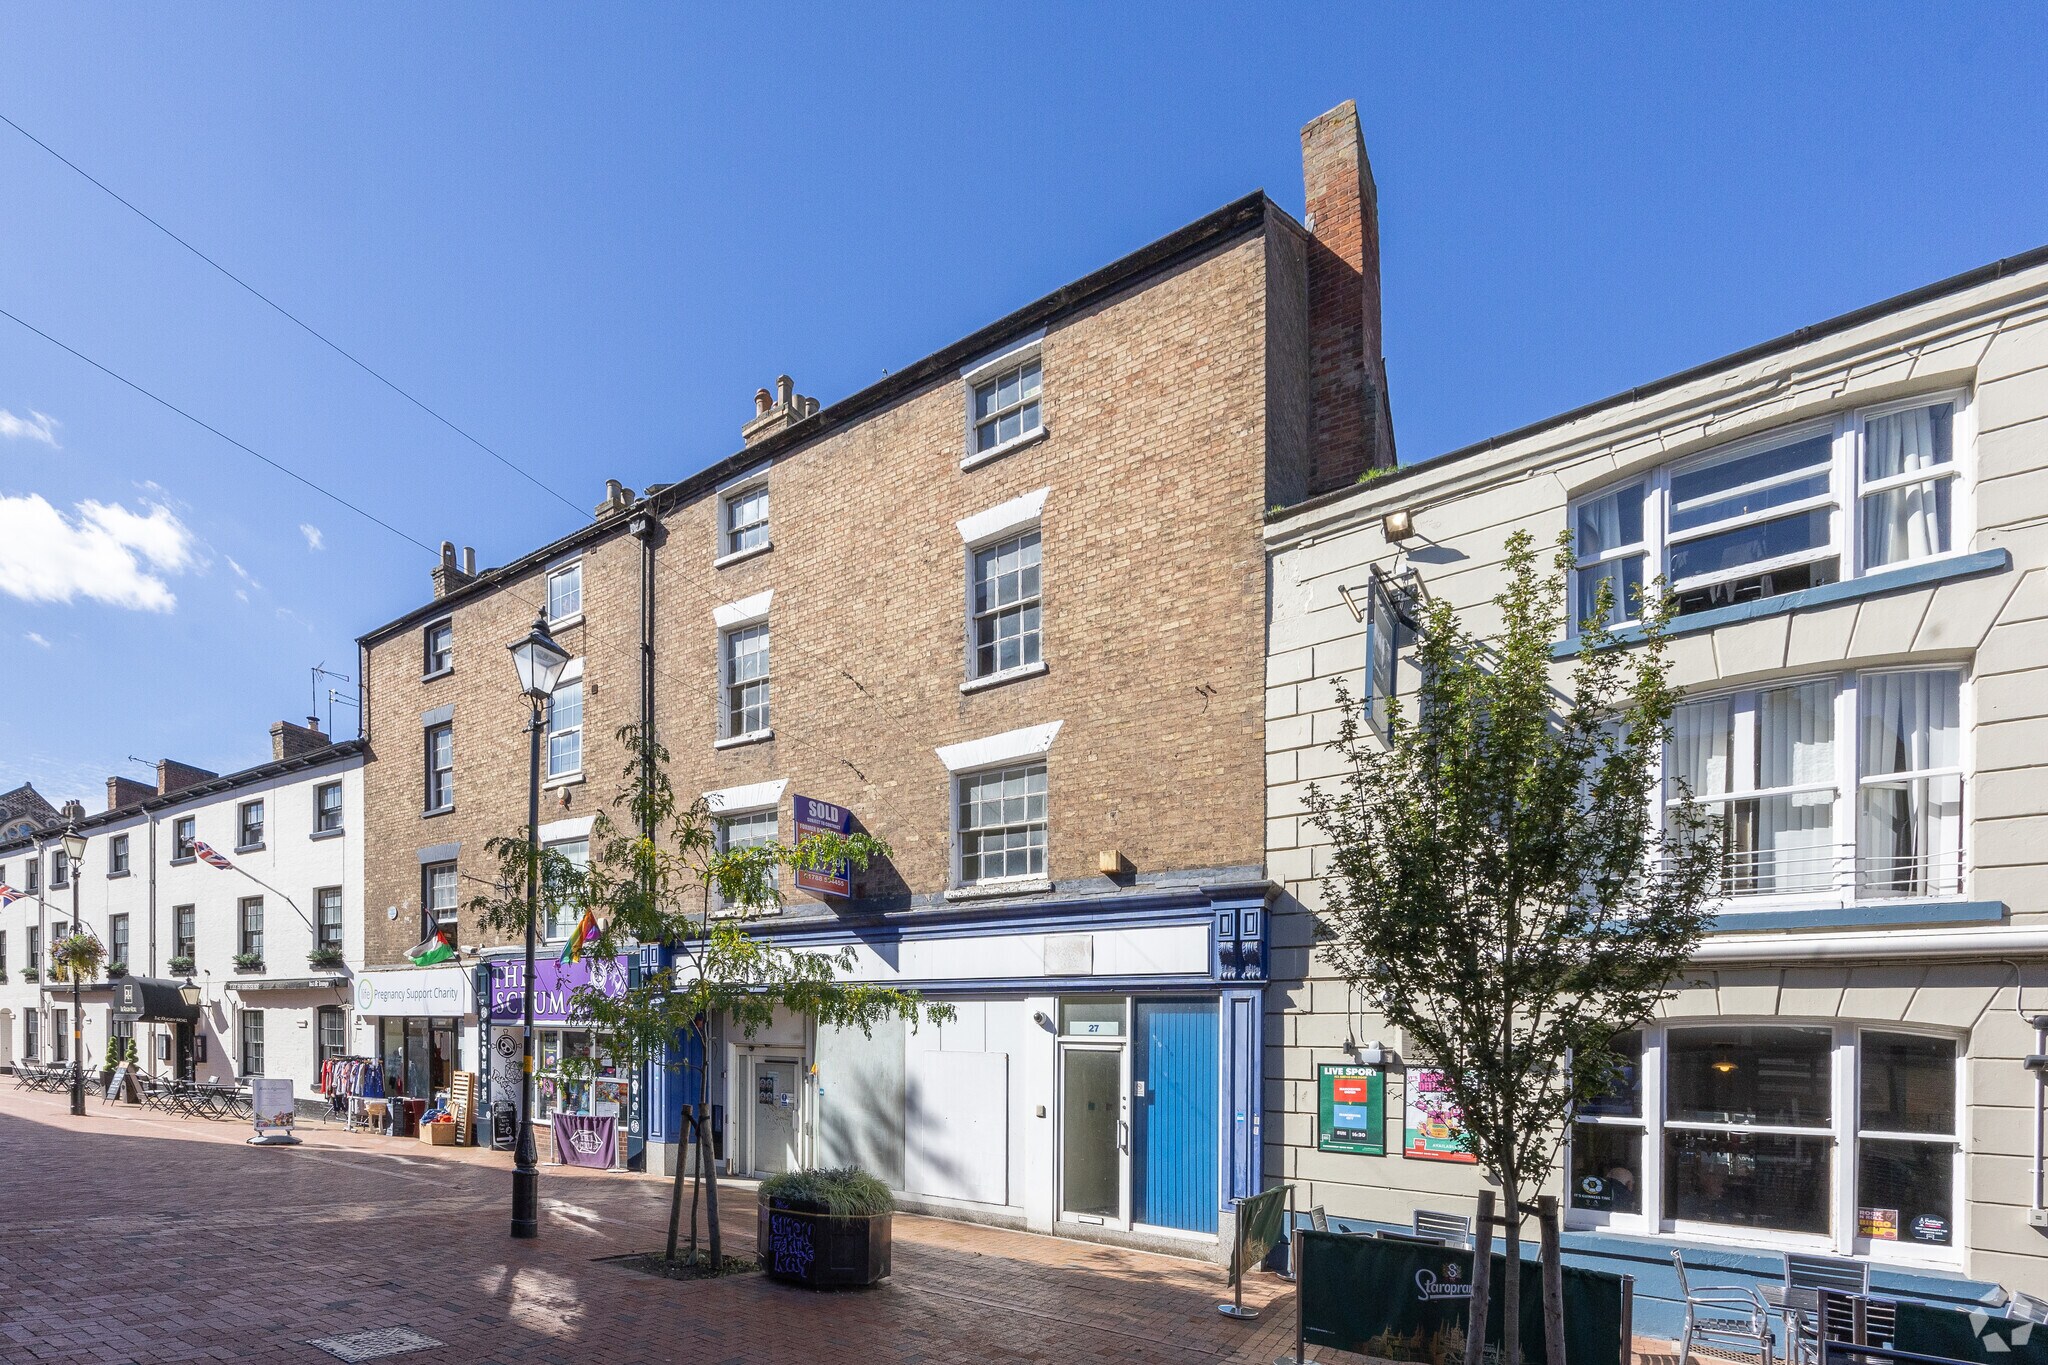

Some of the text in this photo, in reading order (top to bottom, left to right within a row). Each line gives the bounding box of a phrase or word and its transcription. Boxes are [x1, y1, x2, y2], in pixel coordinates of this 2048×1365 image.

[808, 800, 838, 822] SOLD
[374, 989, 405, 1002] Pregnancy
[406, 988, 432, 1001] Support
[434, 988, 458, 1001] Charity
[1088, 1024, 1100, 1032] 27
[1346, 1067, 1377, 1076] SPORT
[1860, 1220, 1892, 1228] BINGO
